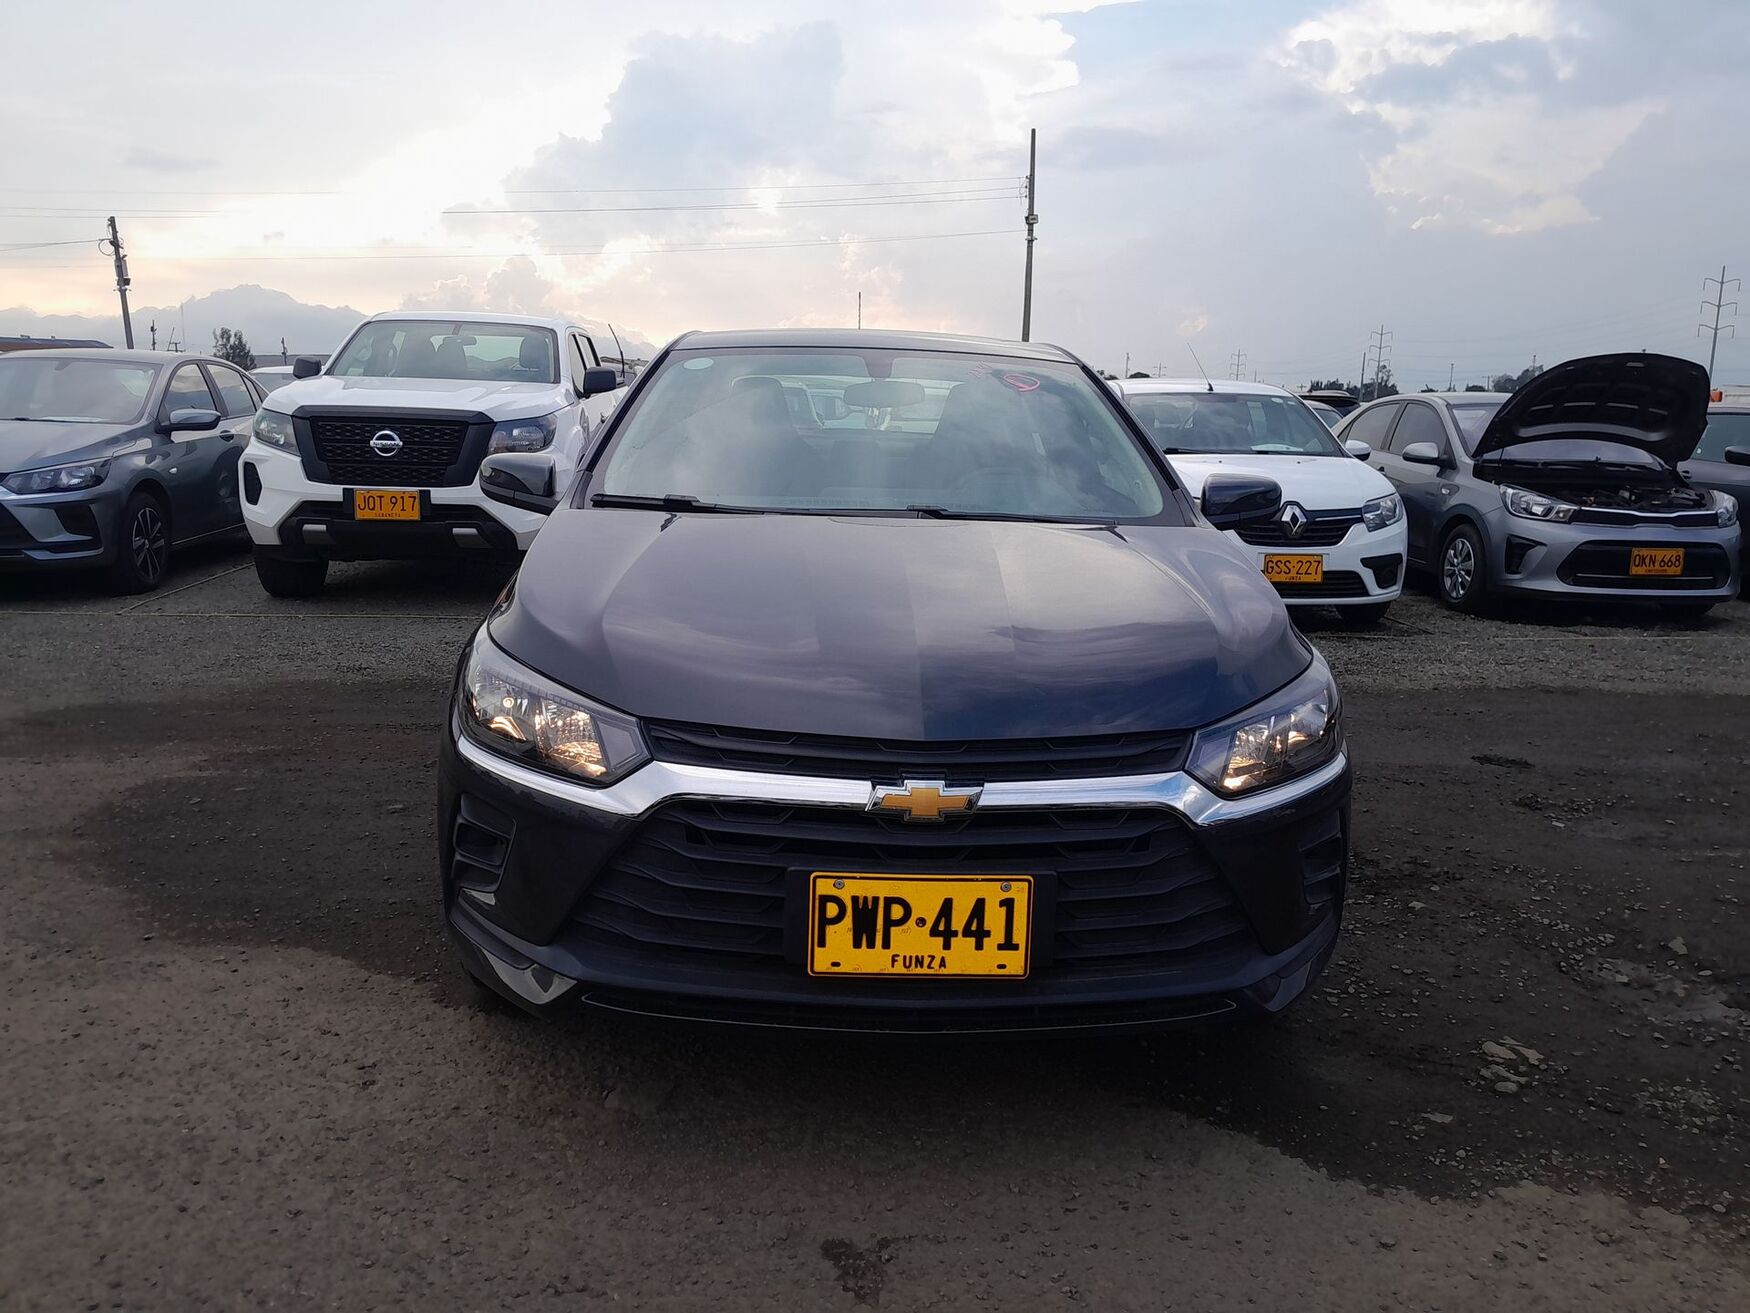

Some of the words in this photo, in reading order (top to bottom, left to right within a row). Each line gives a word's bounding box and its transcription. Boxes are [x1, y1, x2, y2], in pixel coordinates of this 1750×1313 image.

[390, 496, 416, 512] 917
[1659, 554, 1681, 568] 668
[890, 953, 947, 969] FUNZA
